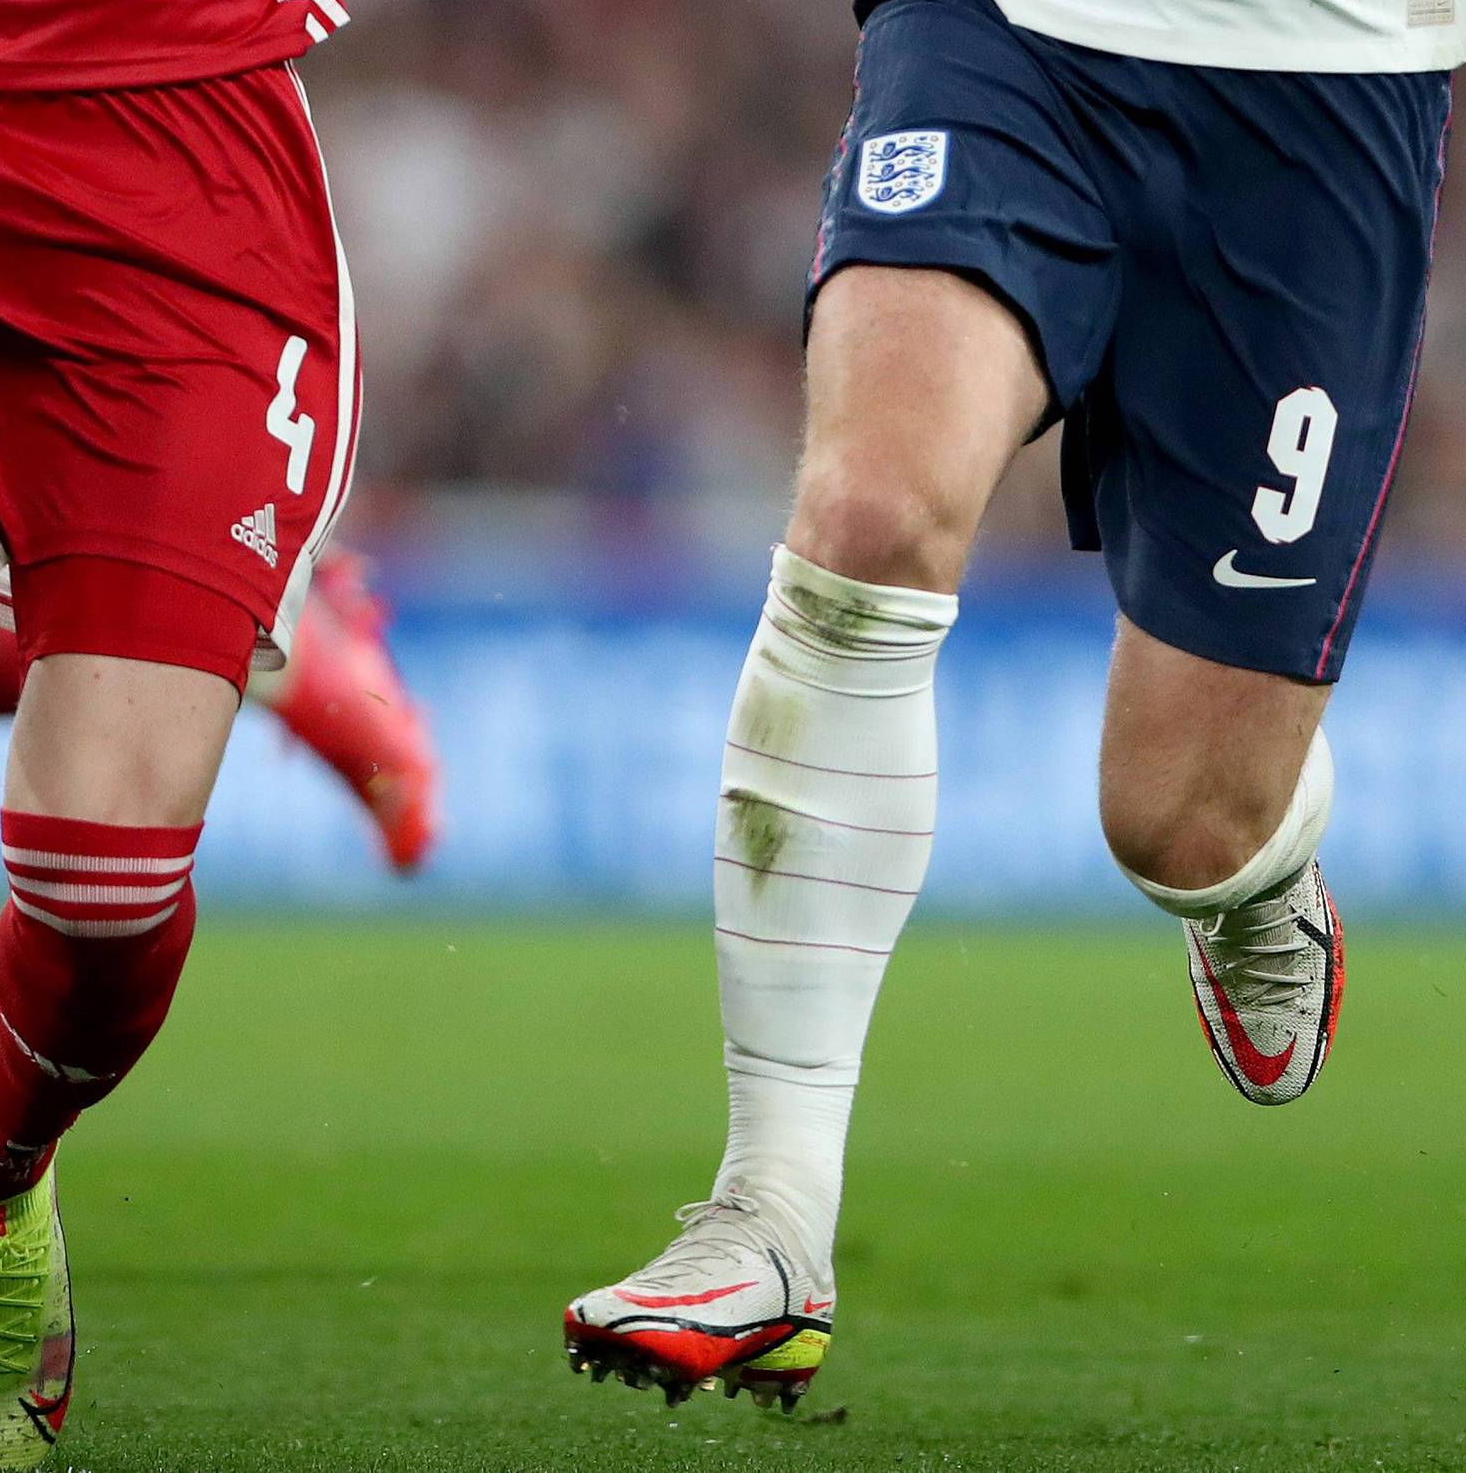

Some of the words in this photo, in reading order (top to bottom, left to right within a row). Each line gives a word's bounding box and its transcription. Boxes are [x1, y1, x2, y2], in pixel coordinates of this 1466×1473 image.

[266, 335, 315, 495] 4
[1250, 386, 1339, 544] 9
[230, 523, 278, 569] adidas
